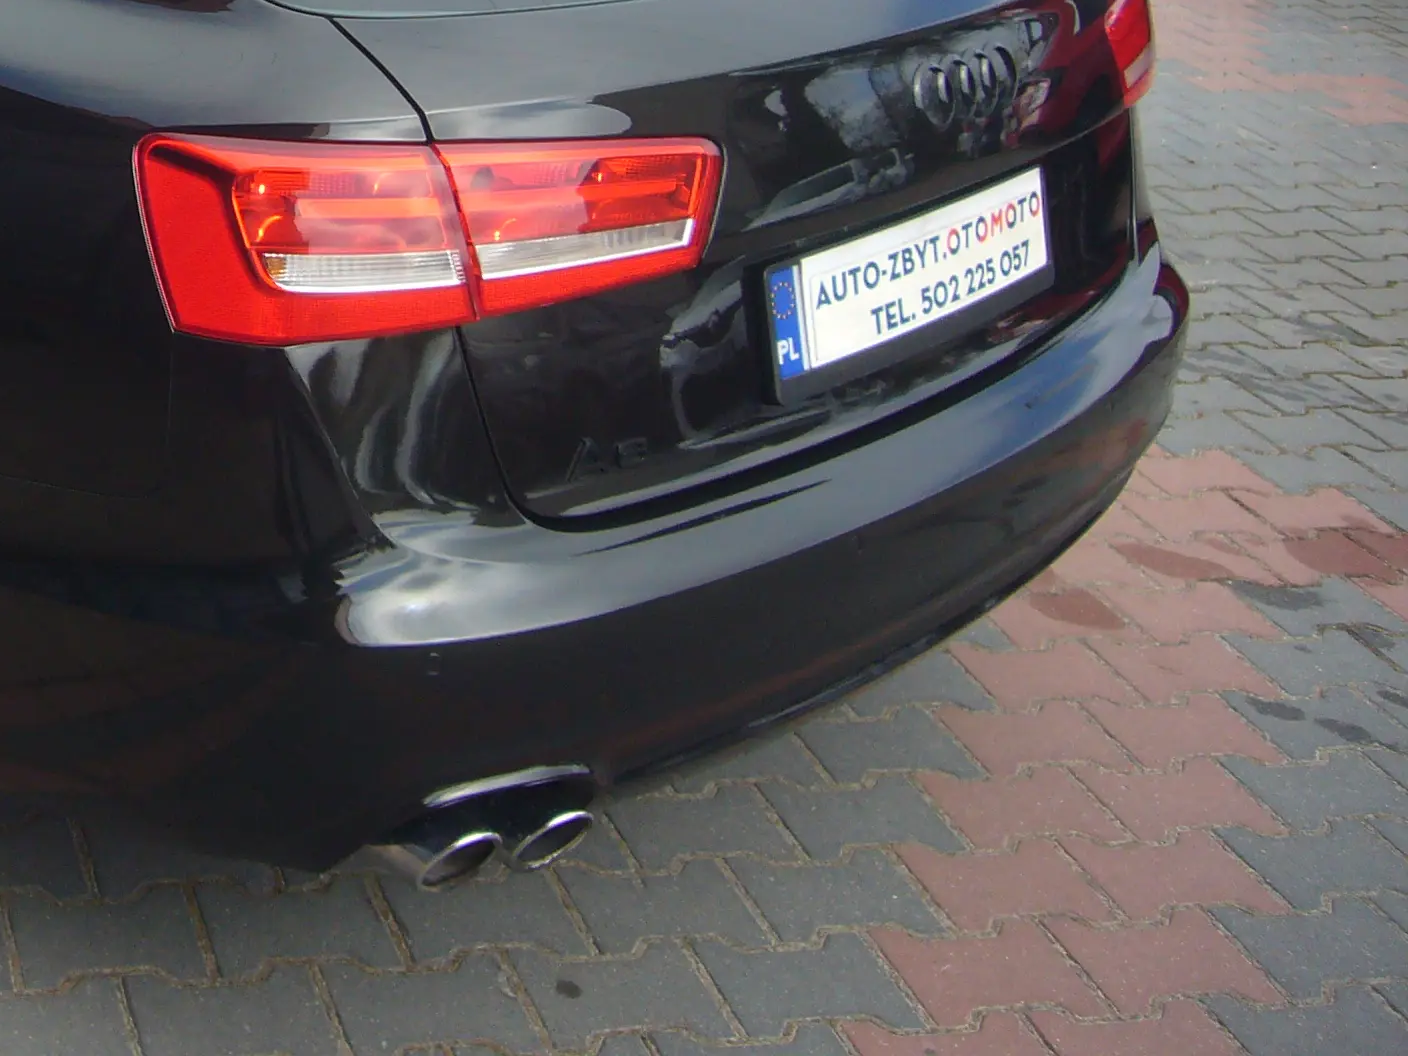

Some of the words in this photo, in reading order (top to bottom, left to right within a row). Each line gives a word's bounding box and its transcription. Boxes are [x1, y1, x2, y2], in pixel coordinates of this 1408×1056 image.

[870, 298, 916, 335] TEL.
[921, 275, 960, 315] 502
[964, 258, 996, 296] 225
[999, 239, 1030, 277] 057
[776, 337, 799, 365] PL
